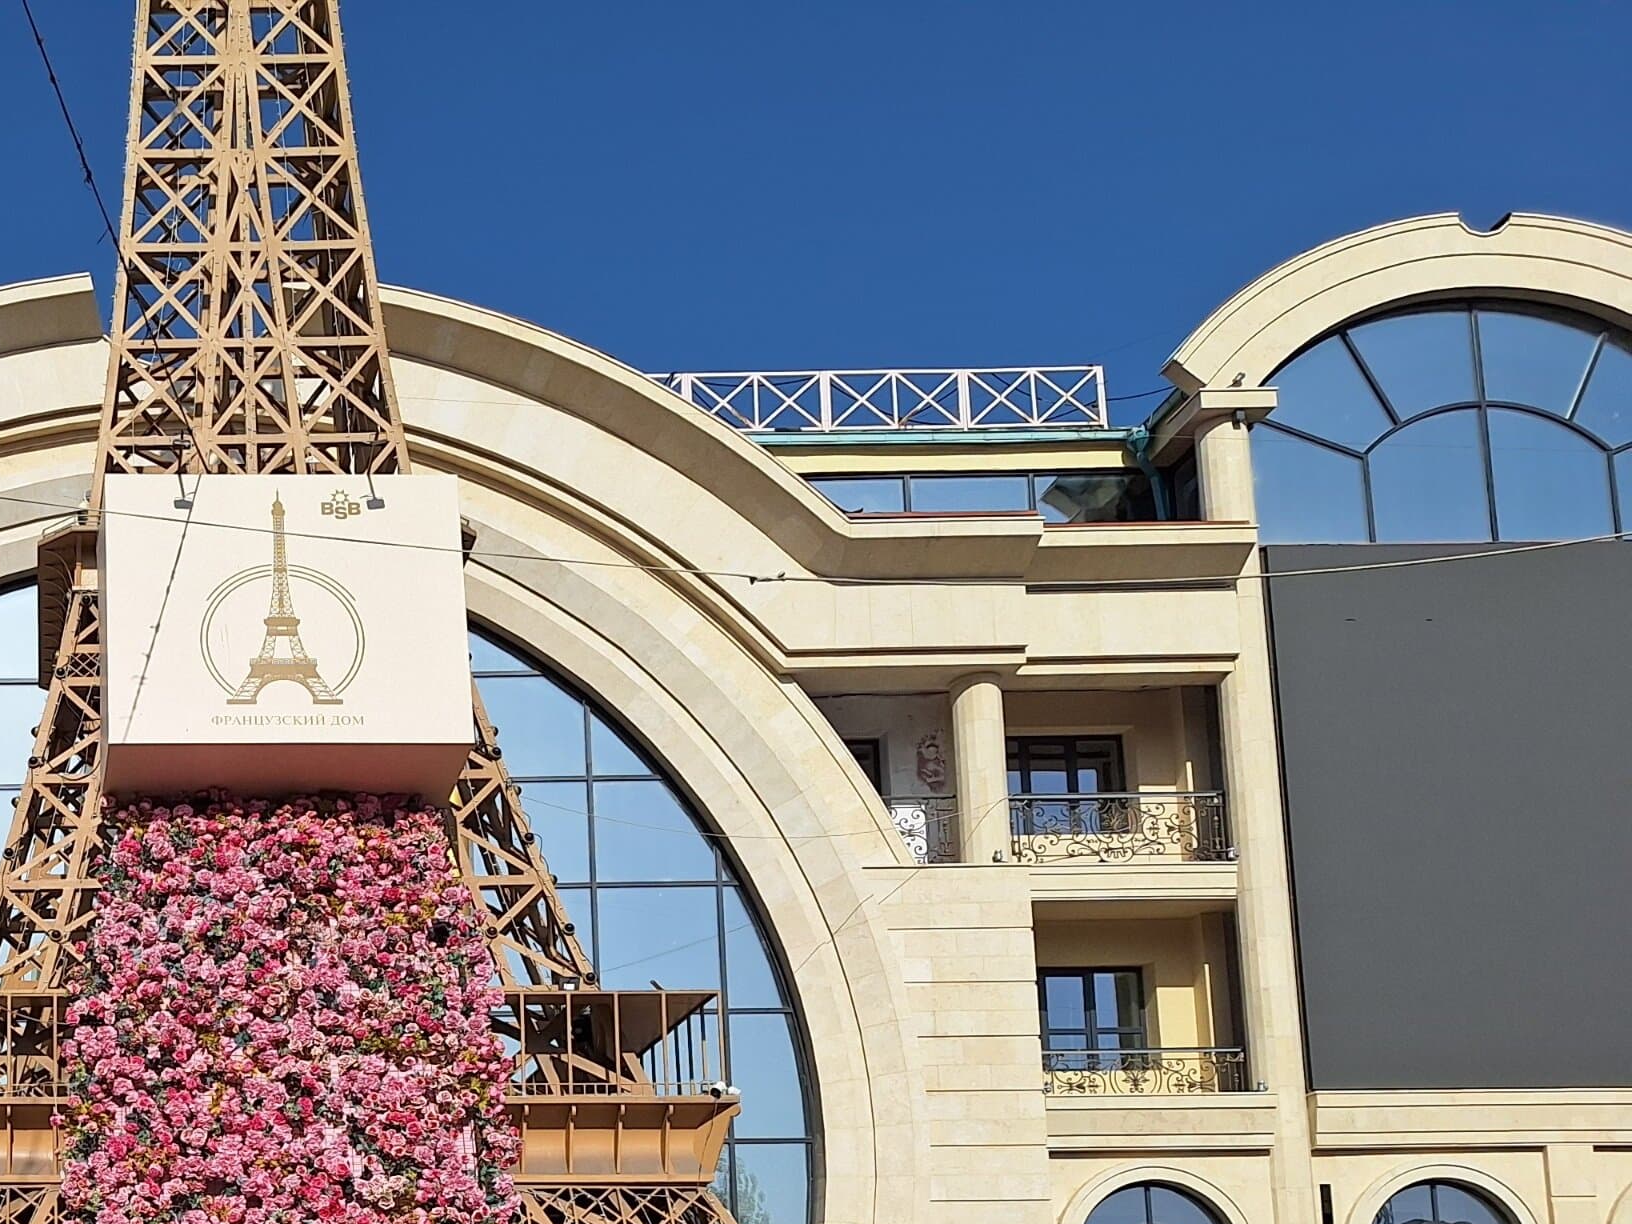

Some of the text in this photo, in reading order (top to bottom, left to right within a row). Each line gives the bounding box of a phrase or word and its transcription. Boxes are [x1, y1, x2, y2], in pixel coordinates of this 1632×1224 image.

[320, 502, 362, 520] BSB
[210, 713, 365, 727] ФРАНЦУЗСКИЙ ДОМ
